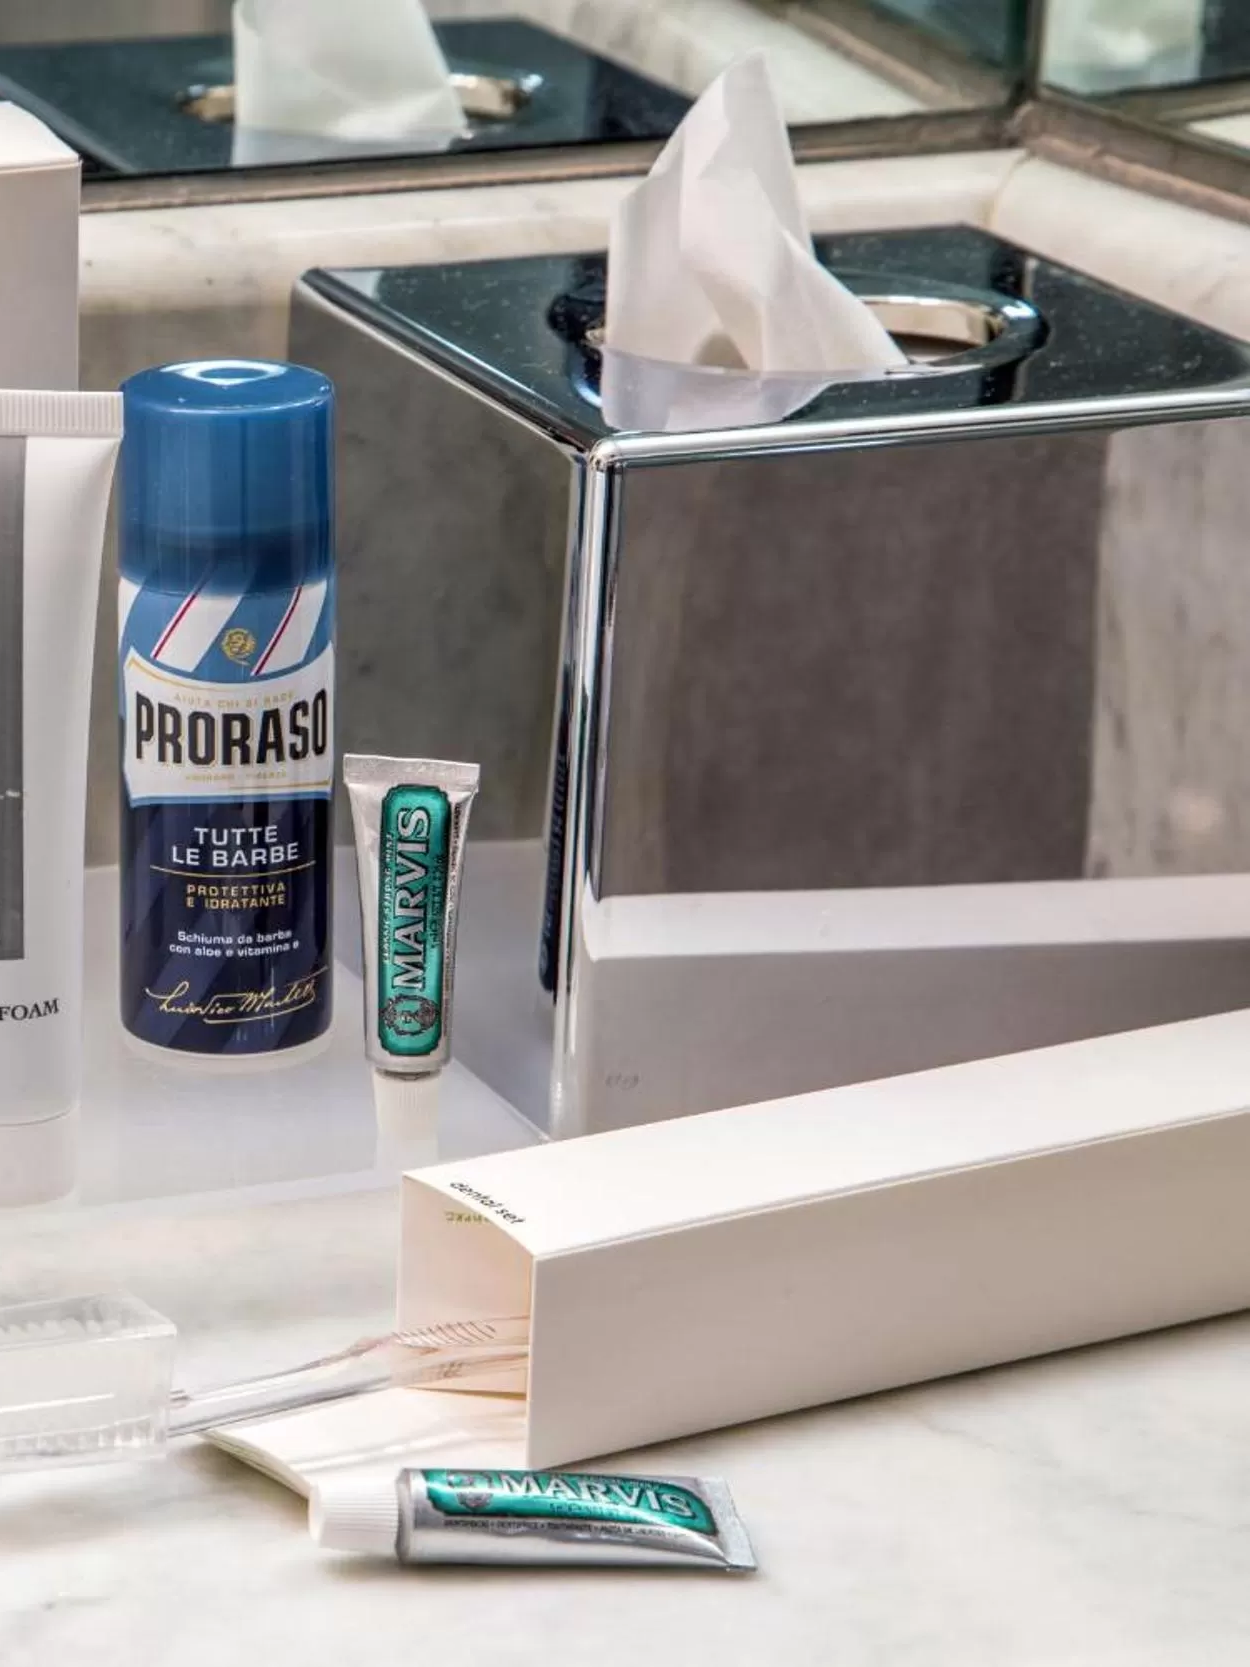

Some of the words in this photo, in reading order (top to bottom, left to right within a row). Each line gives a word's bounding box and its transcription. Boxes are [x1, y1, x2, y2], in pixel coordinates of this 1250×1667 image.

[136, 688, 327, 766] PRORASO
[194, 825, 278, 846] TUTTE
[172, 845, 200, 866] LE
[212, 842, 300, 868] BARBE
[186, 880, 286, 897] PROTETTIVA
[391, 805, 431, 992] MARVIS
[186, 897, 195, 908] E
[205, 895, 286, 910] IDRATANTE
[177, 930, 234, 945] Schiuma
[237, 933, 253, 944] da
[257, 929, 293, 943] barba
[169, 942, 192, 954] con
[195, 944, 221, 958] aloe
[237, 941, 290, 957] vitamina
[500, 1473, 698, 1520] MARVIS
